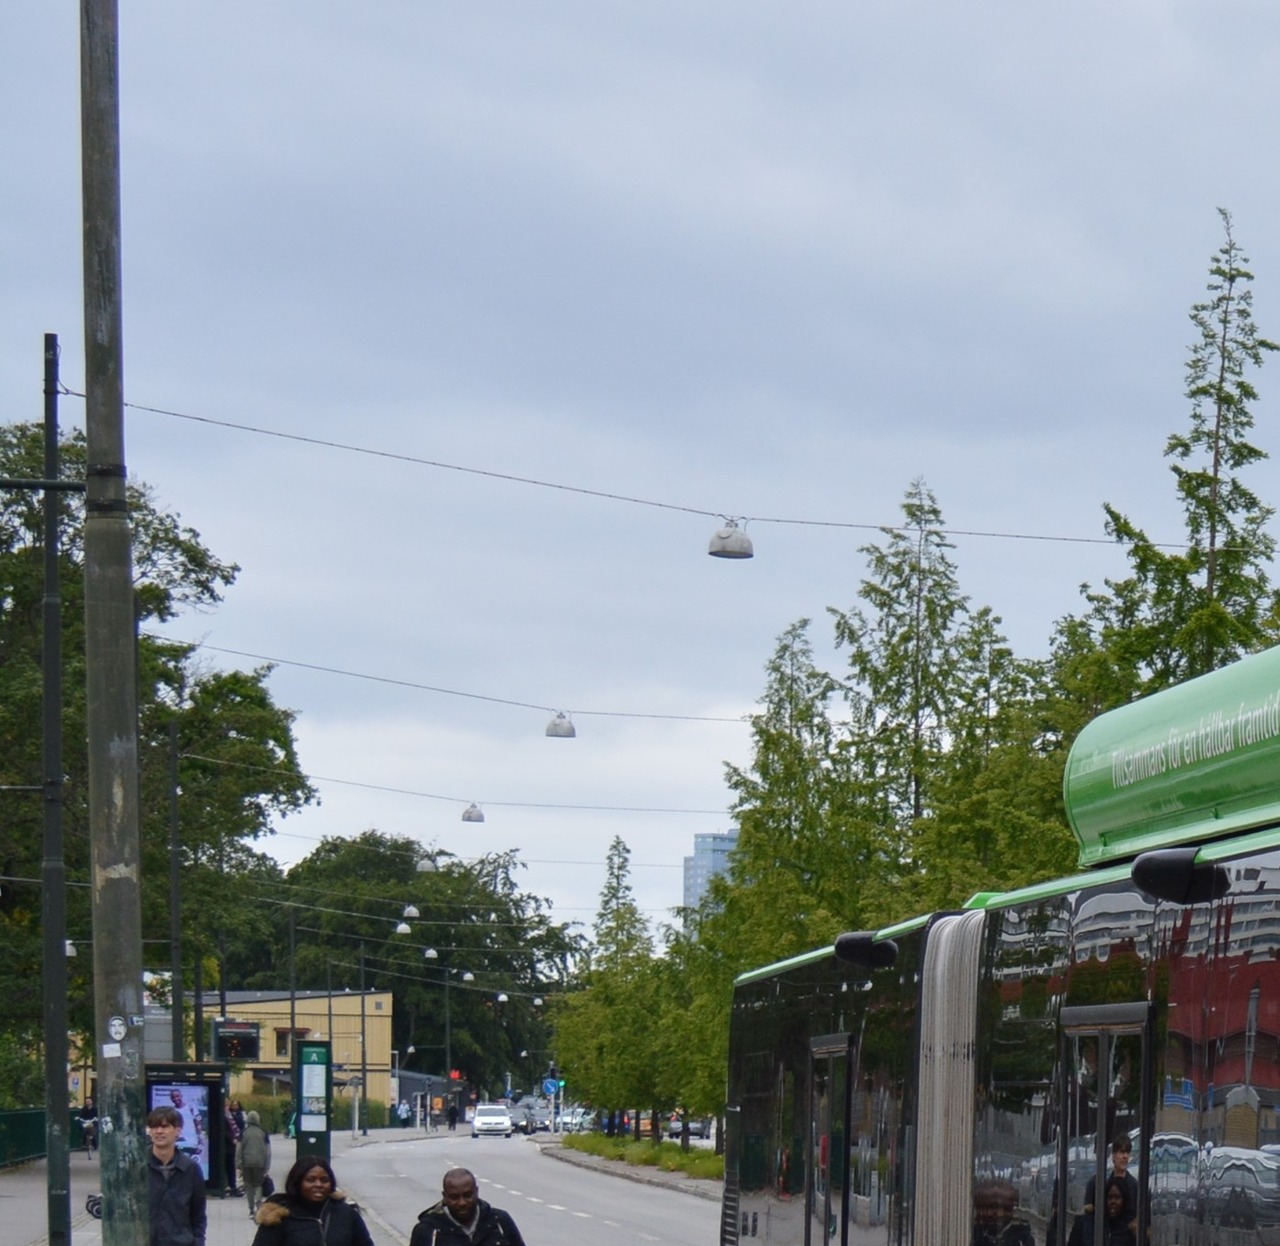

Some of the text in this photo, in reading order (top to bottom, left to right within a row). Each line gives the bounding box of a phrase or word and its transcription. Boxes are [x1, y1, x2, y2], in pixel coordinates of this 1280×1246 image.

[1111, 689, 1280, 790] Tillsammans för en hållbar framtid
